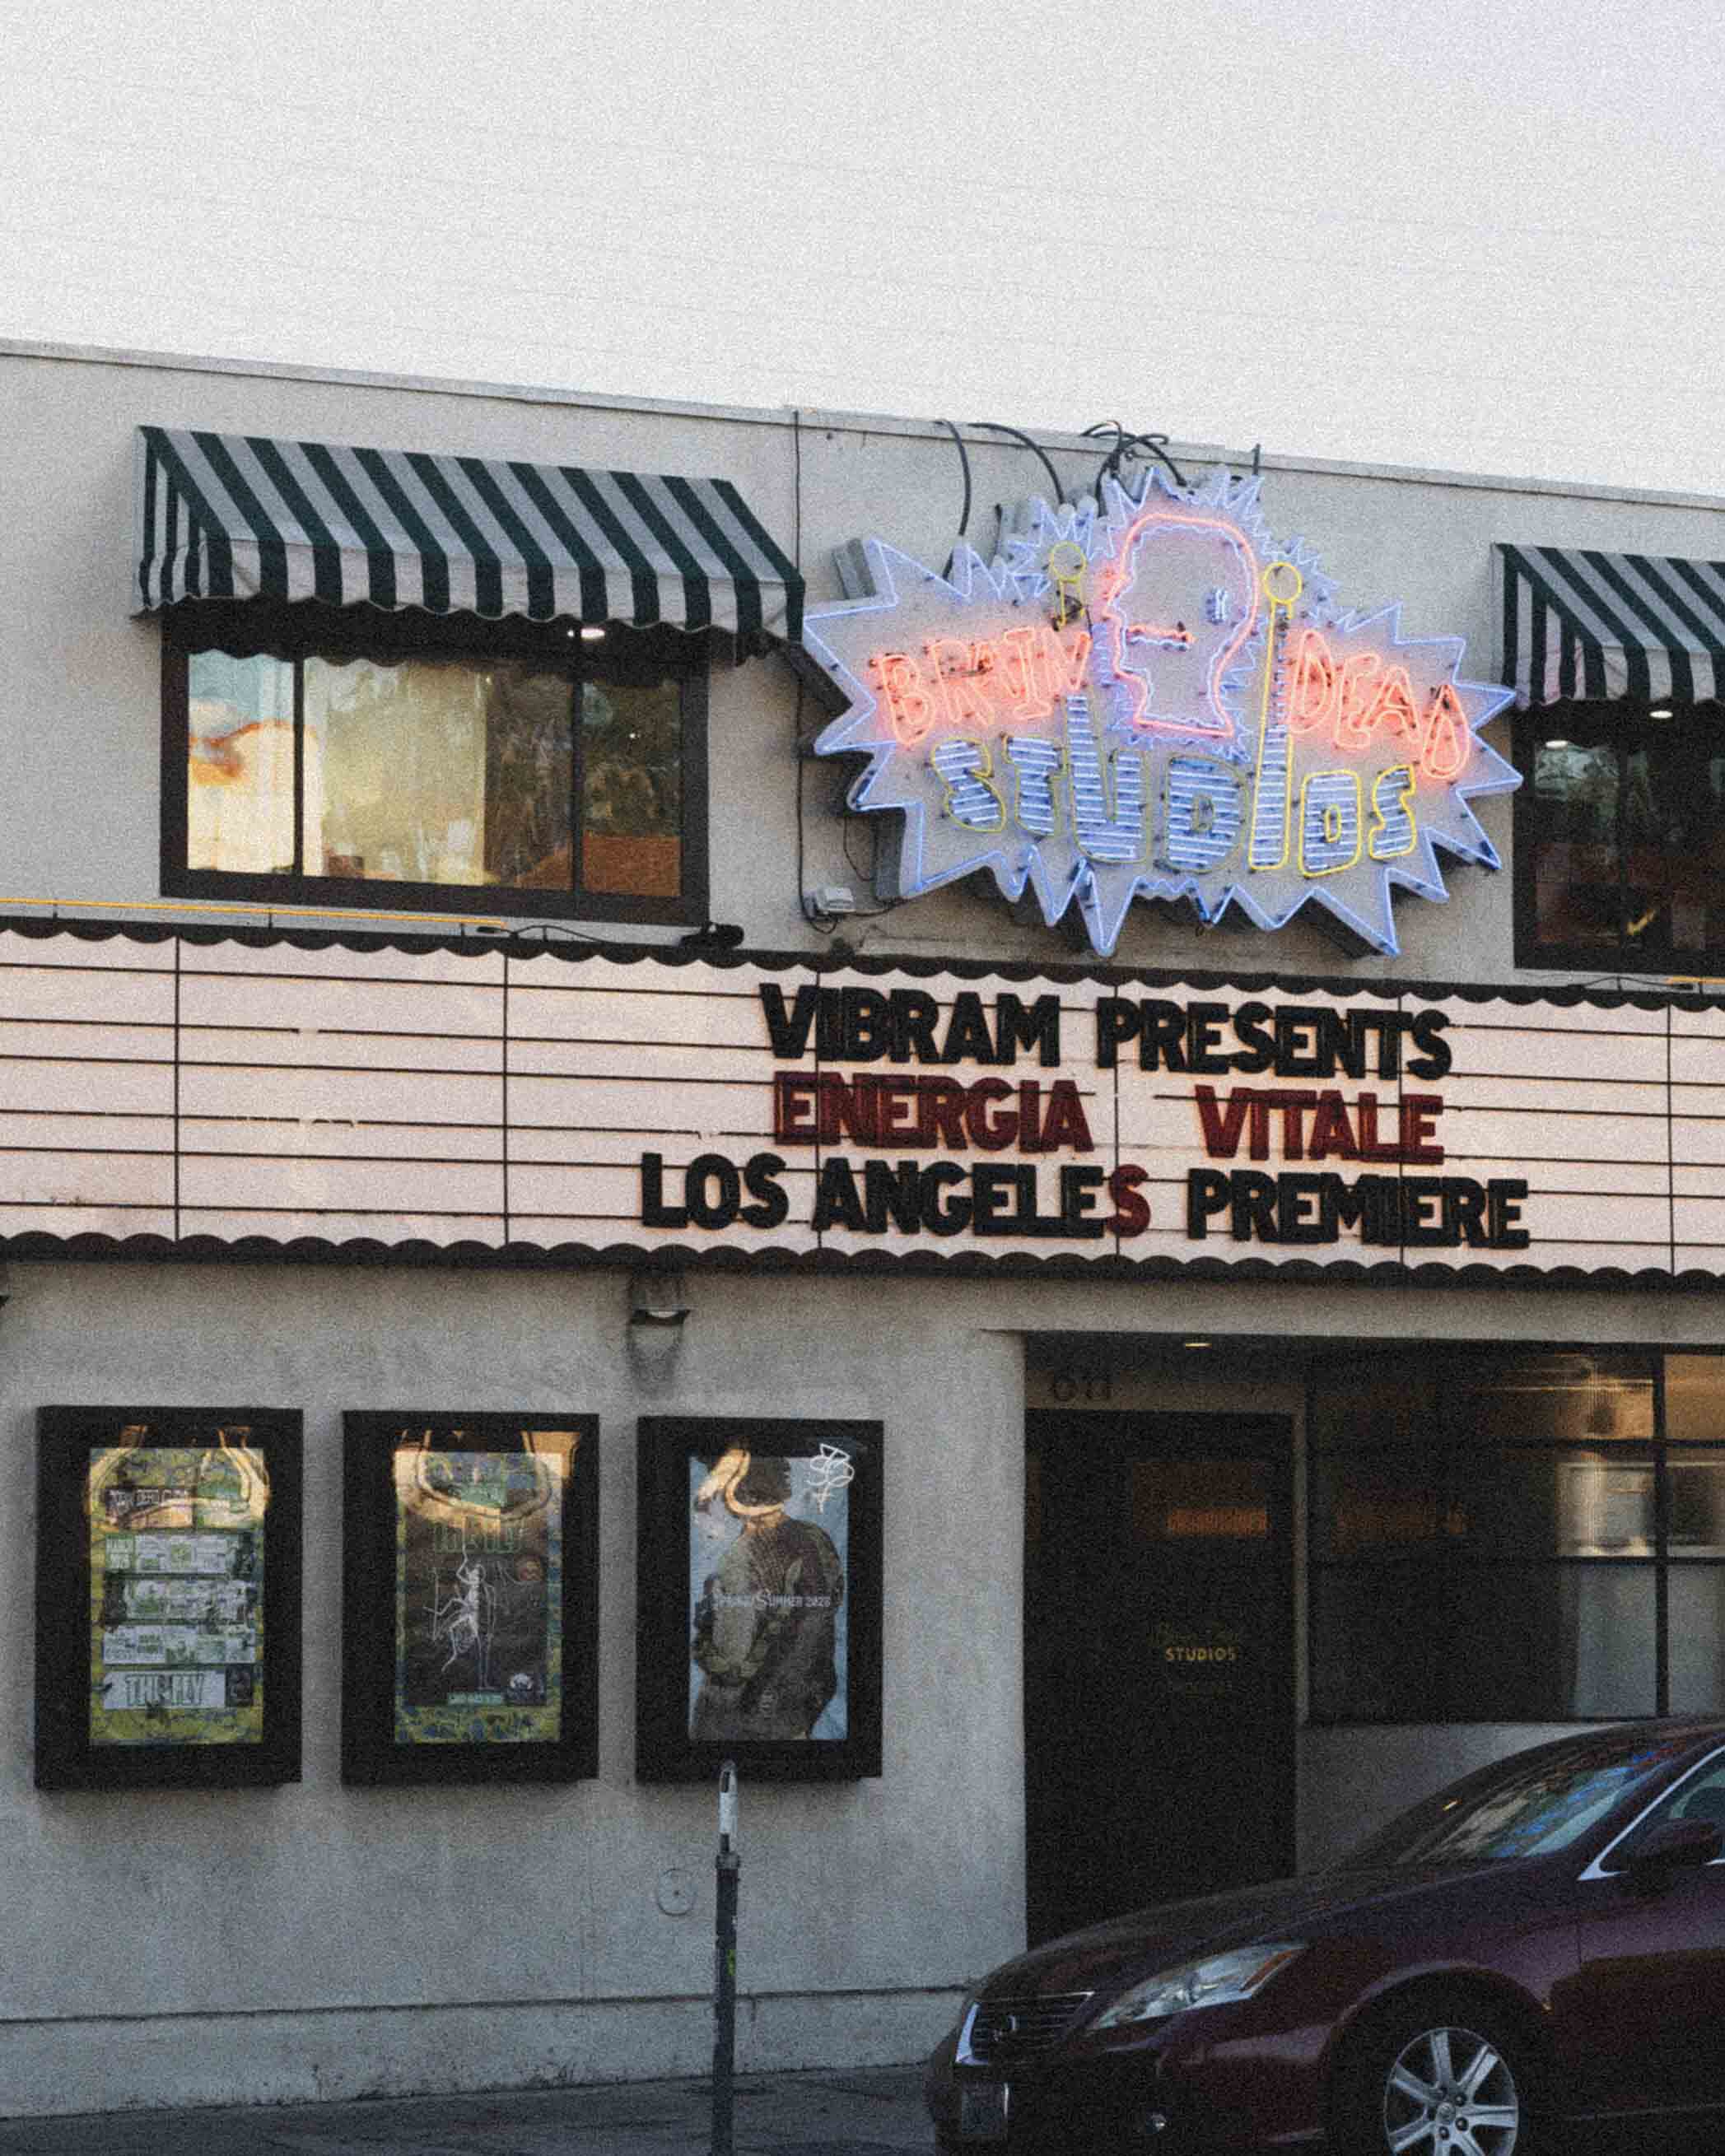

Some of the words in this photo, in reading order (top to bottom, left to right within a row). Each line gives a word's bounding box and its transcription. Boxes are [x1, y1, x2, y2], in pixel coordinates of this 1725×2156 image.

[877, 626, 1093, 747] BRAIN
[1289, 629, 1470, 780] DEAD
[758, 982, 1061, 1069] VIBRAM
[1096, 997, 1453, 1081] PRESENTS
[775, 1071, 1095, 1153] ENERGIA
[1195, 1084, 1444, 1165] VITALE
[641, 1152, 790, 1230] LOS
[811, 1157, 1151, 1239] ANGELES
[1187, 1168, 1530, 1250] PREMIERE
[125, 1674, 170, 1706] TH
[1165, 1646, 1237, 1662] STUDIOS
